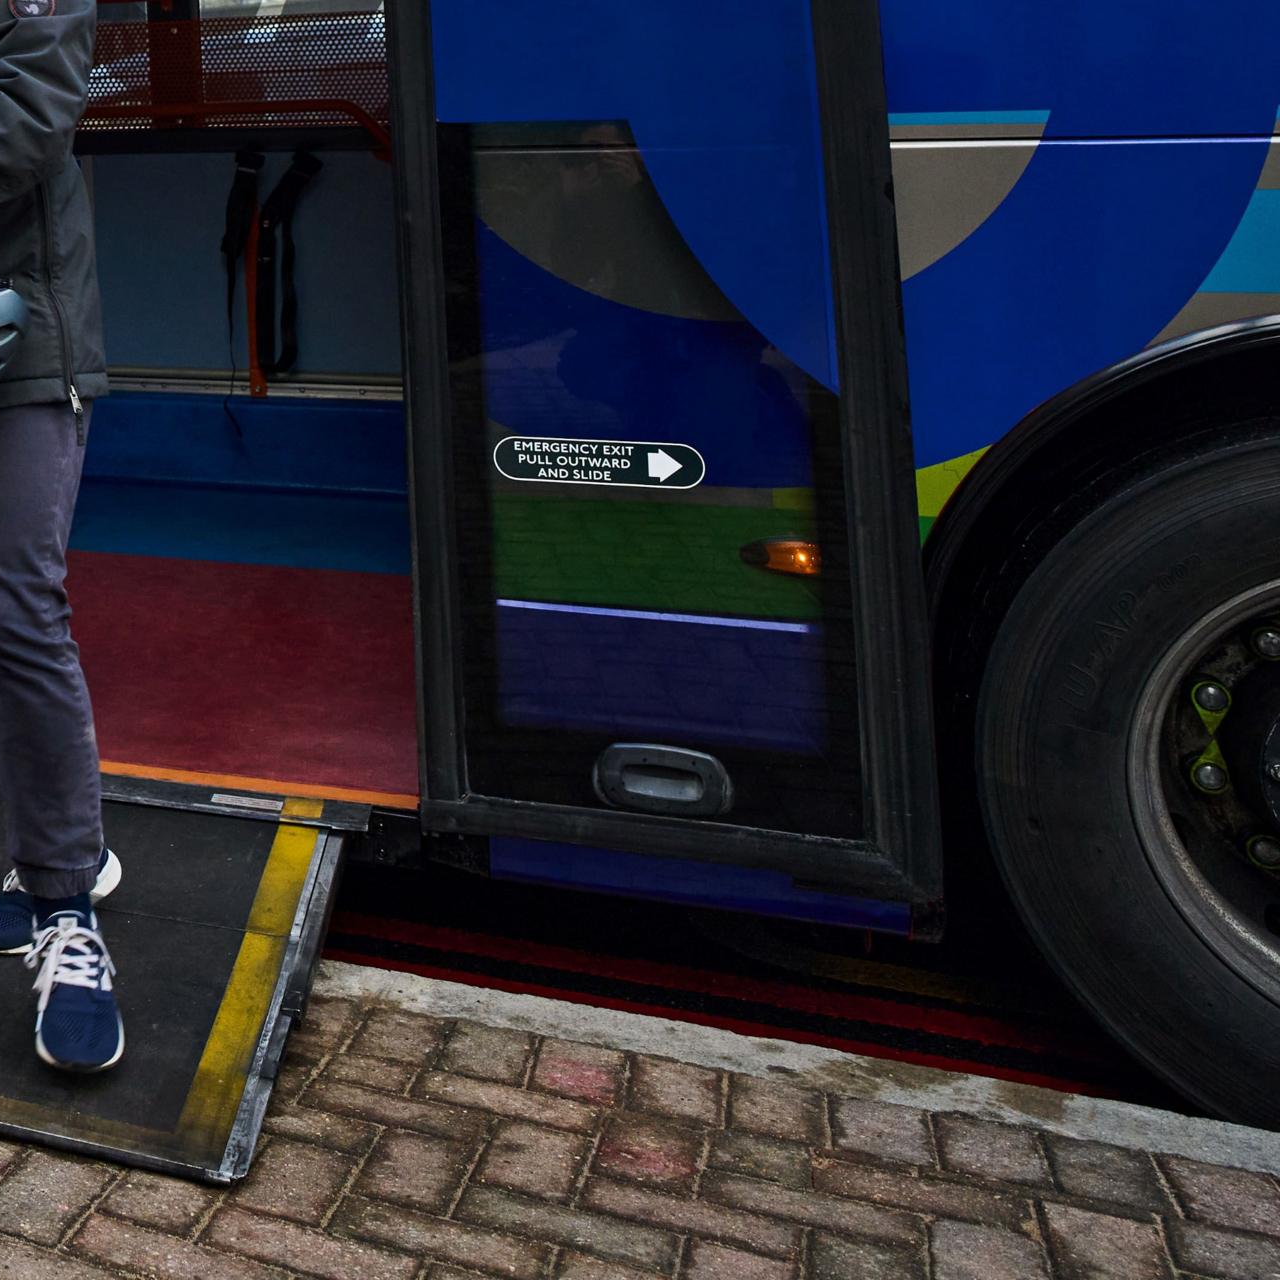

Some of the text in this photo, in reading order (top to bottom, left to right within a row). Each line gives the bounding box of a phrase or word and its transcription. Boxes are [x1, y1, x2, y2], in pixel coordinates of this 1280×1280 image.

[514, 440, 634, 456] EMERGENCY EXIT
[518, 453, 631, 469] PULL OUTWARD
[537, 468, 612, 481] AND SLIDE
